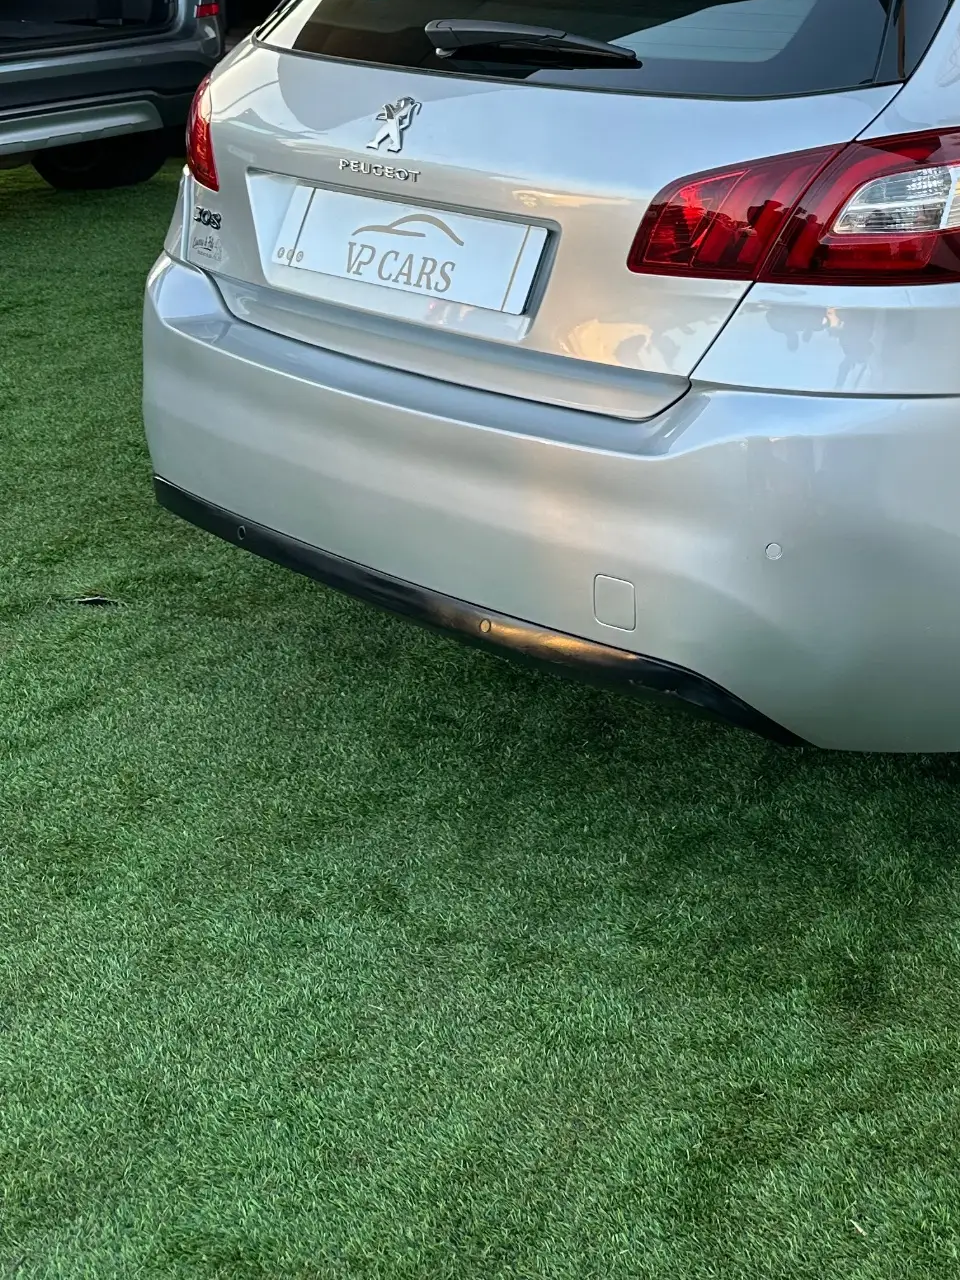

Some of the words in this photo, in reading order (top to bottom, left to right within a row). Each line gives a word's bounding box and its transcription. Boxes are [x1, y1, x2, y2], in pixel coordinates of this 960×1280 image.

[338, 158, 421, 183] PEUGEOT
[193, 205, 222, 230] 308
[346, 241, 376, 275] VP
[377, 250, 456, 292] CARS
